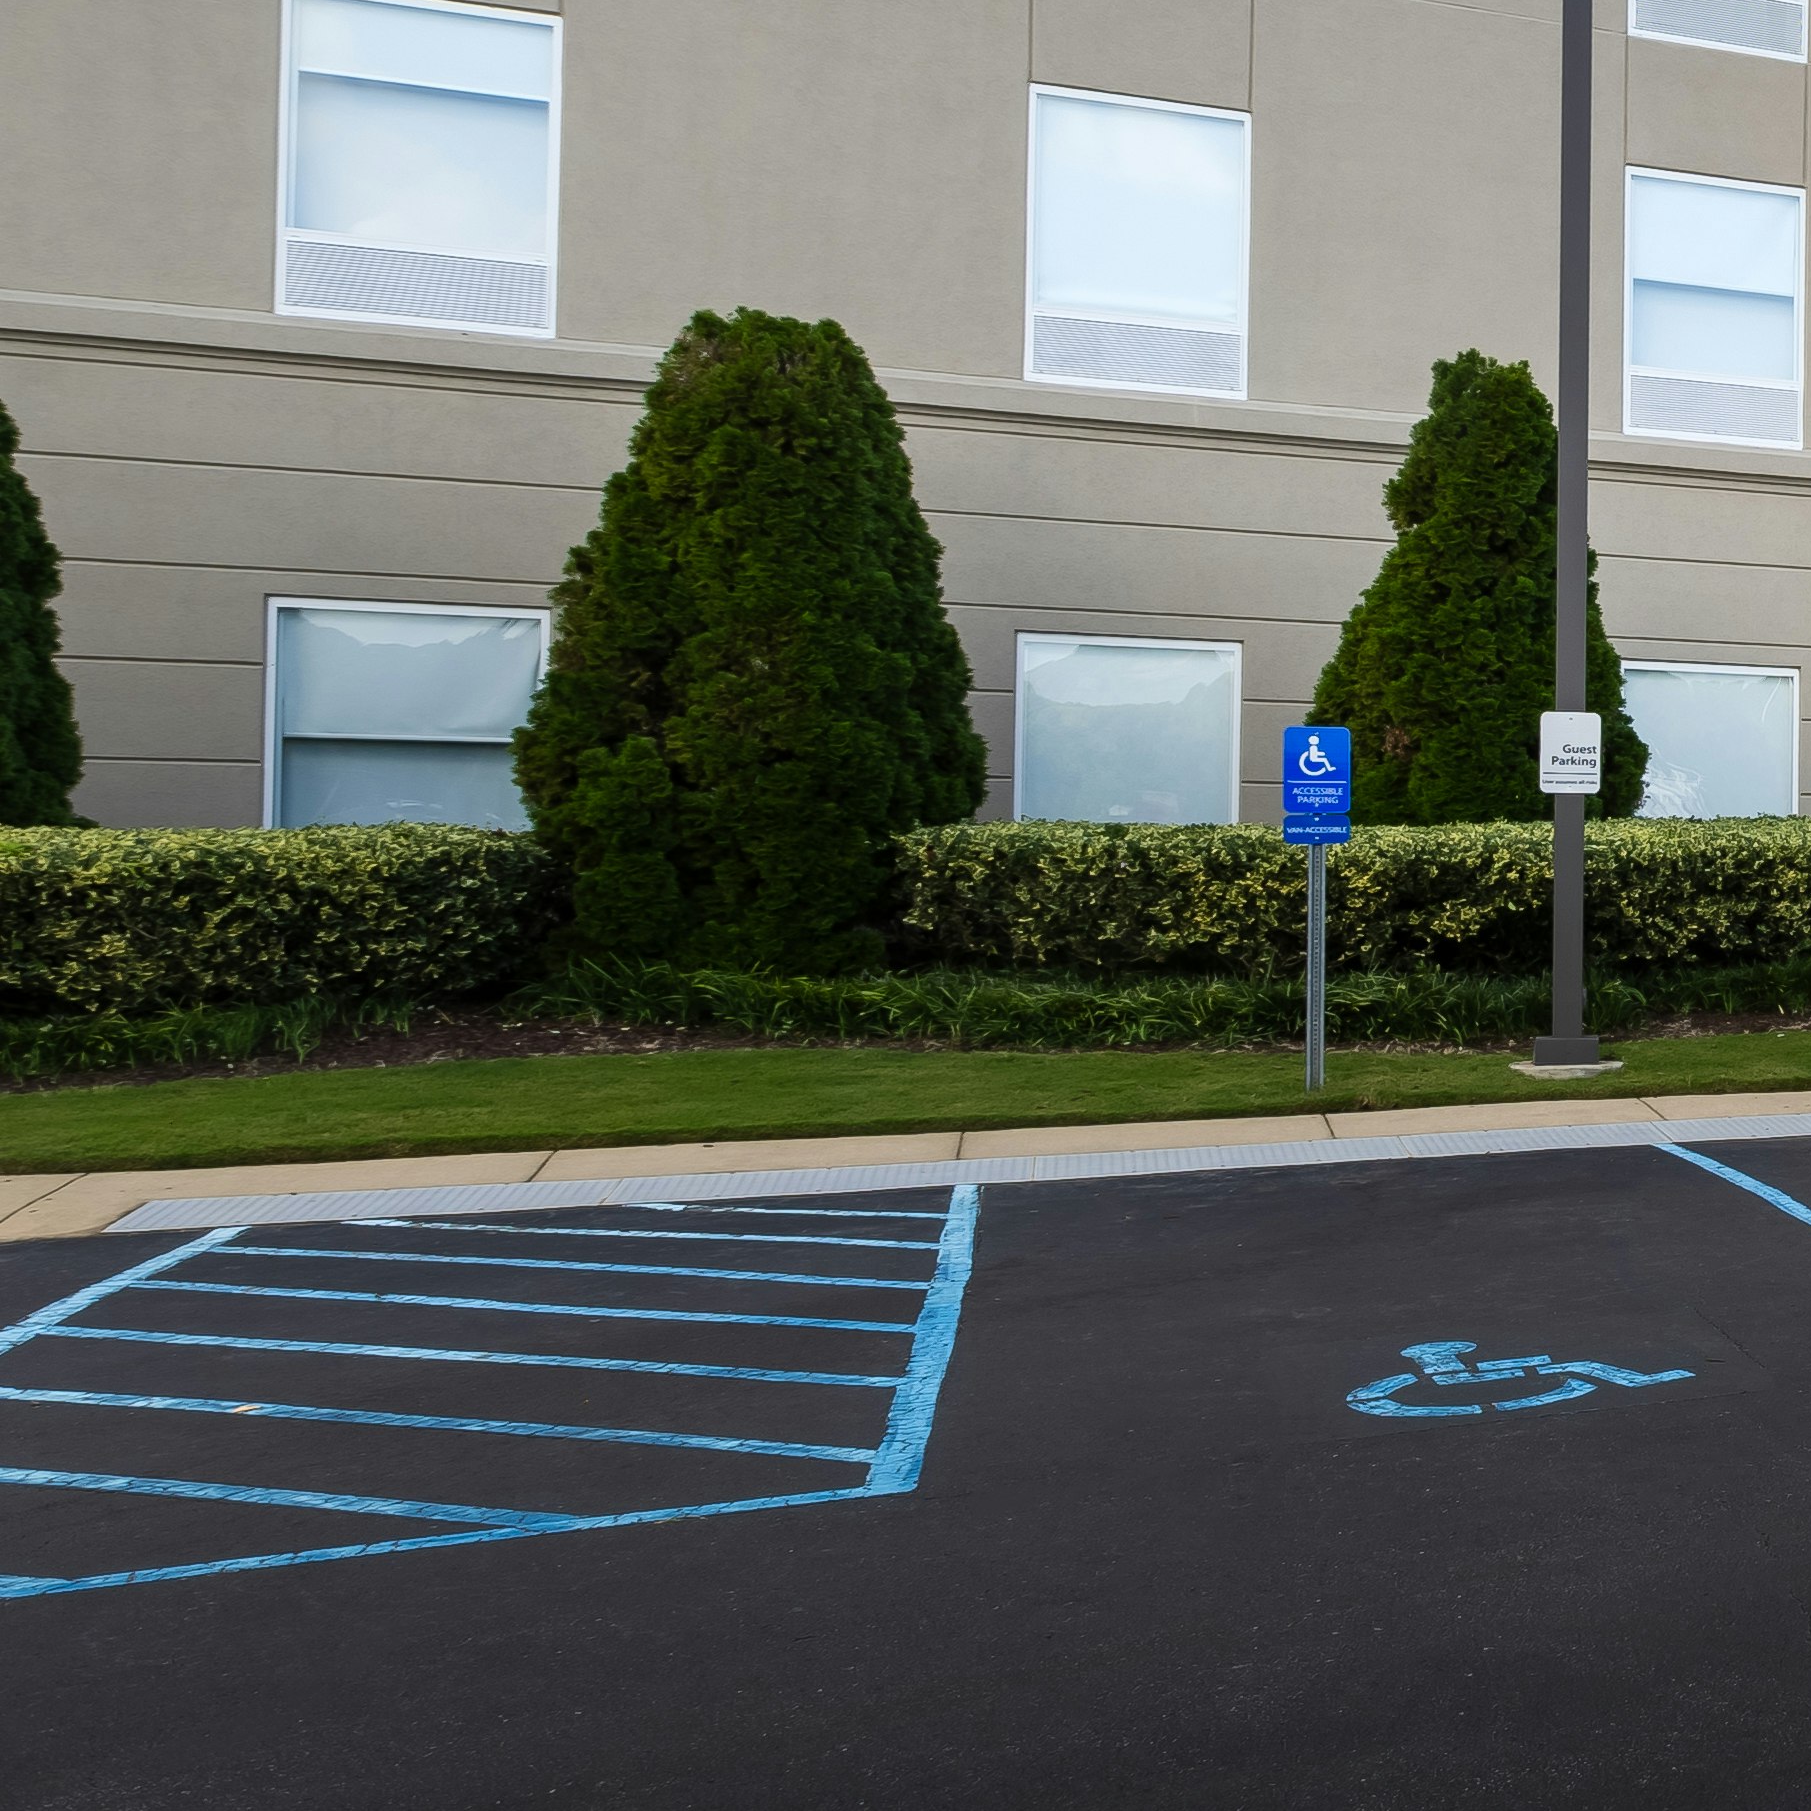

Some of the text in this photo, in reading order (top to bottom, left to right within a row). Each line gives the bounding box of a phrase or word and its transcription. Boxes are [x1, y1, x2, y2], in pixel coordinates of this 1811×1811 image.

[1562, 744, 1597, 754] Guest
[1551, 755, 1597, 769] Parking
[1292, 787, 1344, 796] ACCESSIBLE
[1297, 796, 1339, 804] PARKING
